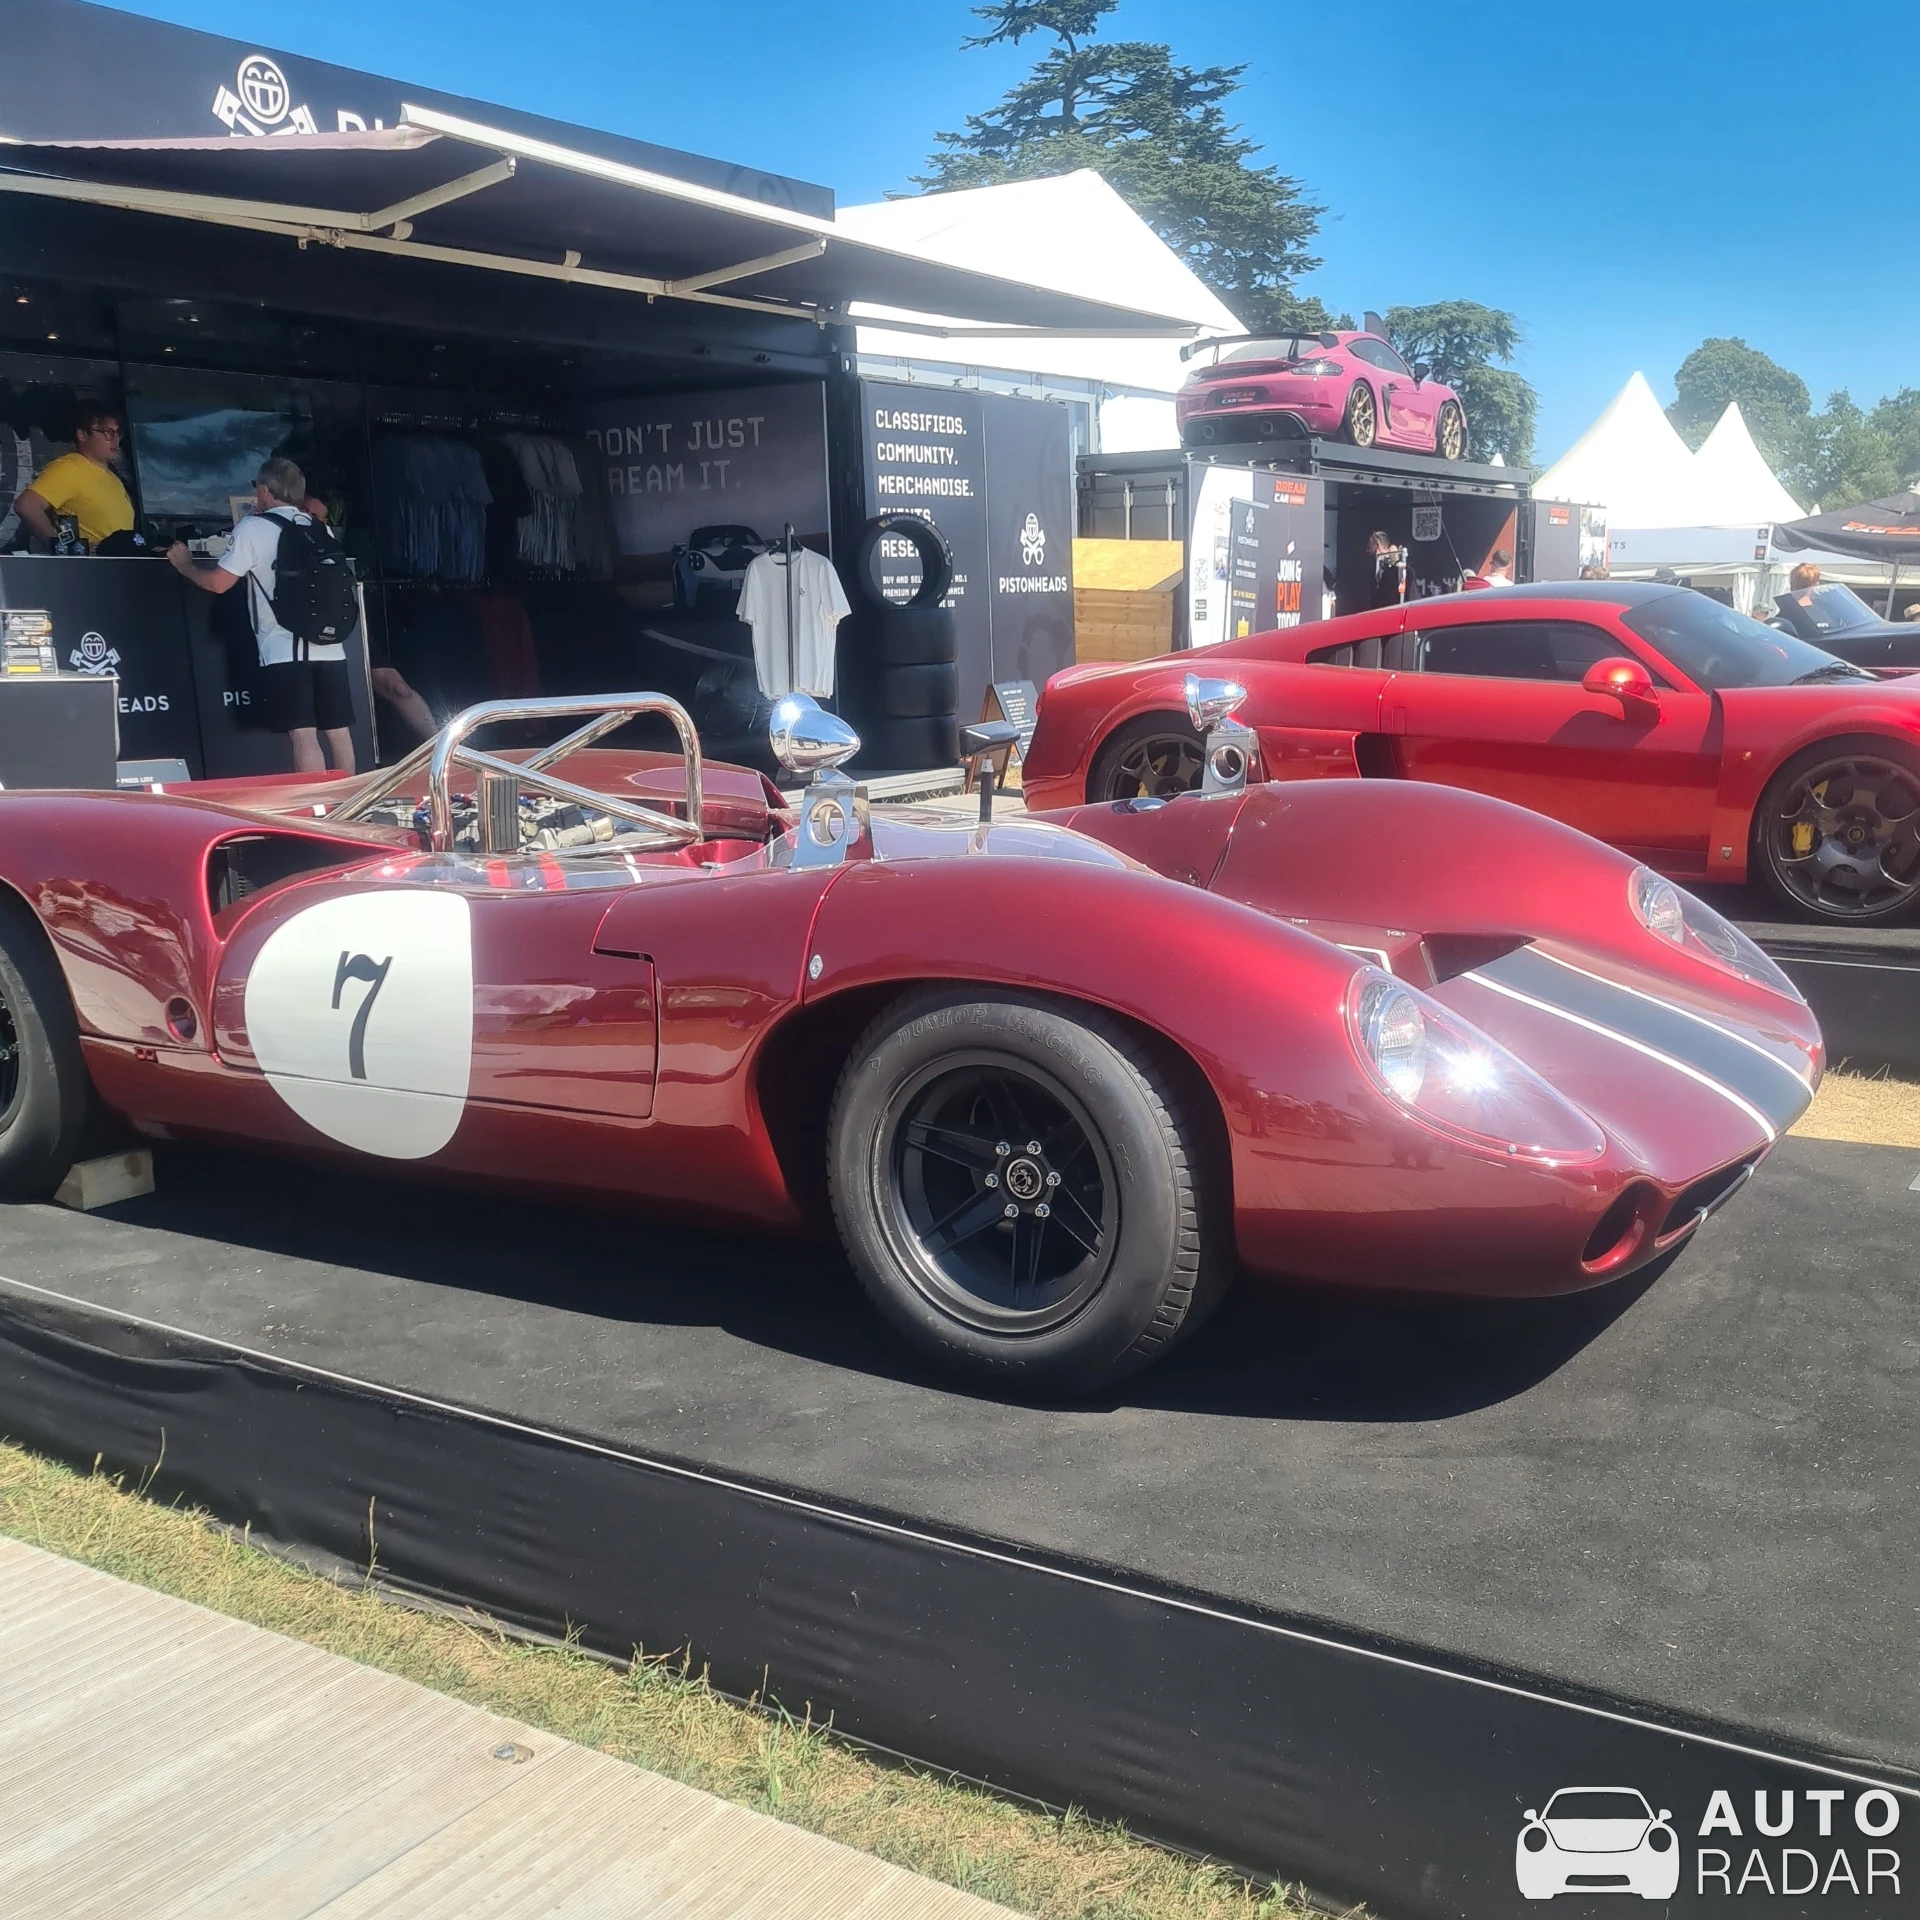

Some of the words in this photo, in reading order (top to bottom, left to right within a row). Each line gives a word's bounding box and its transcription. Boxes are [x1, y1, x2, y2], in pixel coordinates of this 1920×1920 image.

[687, 416, 765, 451] JUST
[875, 409, 967, 435] CLASSIFIEDS.
[877, 442, 958, 466] COMMUNITY.
[608, 462, 685, 495] REAM
[700, 459, 741, 490] IT.
[878, 475, 974, 497] MERCHANDISE.
[1275, 479, 1307, 495] DREAM
[1274, 492, 1289, 504] CAR
[882, 575, 895, 585] BUY
[896, 574, 909, 584] AND
[911, 574, 923, 584] SEL
[1277, 559, 1295, 582] JOIN
[1295, 560, 1302, 582] &
[882, 588, 910, 598] PREMIUM
[999, 576, 1068, 594] PISTONHEADS
[1277, 582, 1302, 611] PLAY
[1276, 612, 1301, 630] TODAY
[331, 950, 393, 1080] 7
[898, 1007, 988, 1047] DUNLOP
